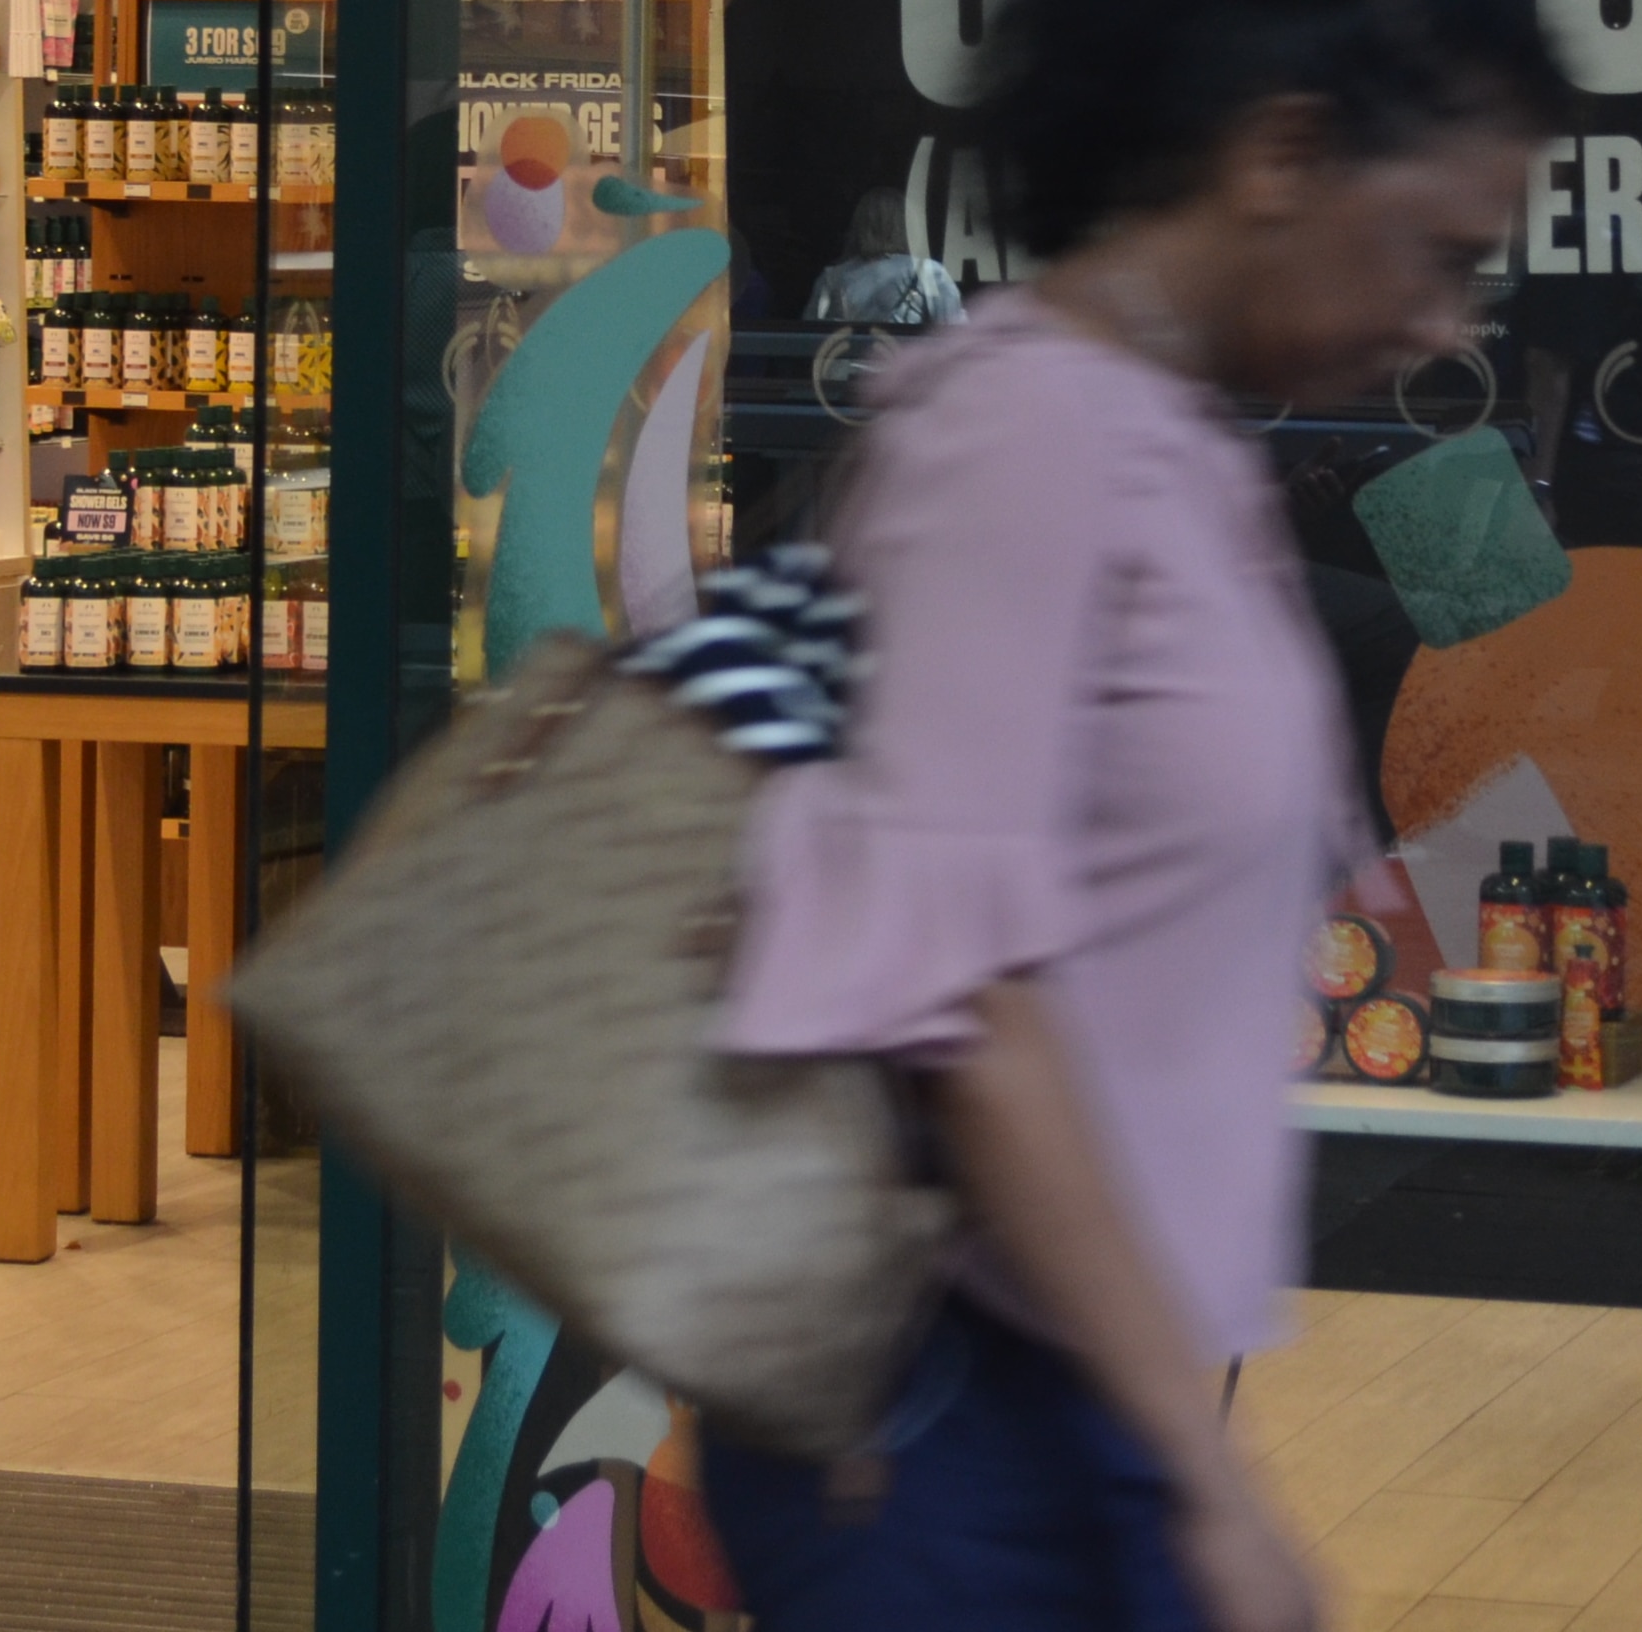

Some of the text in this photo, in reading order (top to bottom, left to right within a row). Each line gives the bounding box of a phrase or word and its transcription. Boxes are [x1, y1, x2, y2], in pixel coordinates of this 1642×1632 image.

[186, 27, 287, 57] 3 FOR $9
[544, 72, 623, 90] FRIDA
[77, 514, 116, 529] NOW $9
